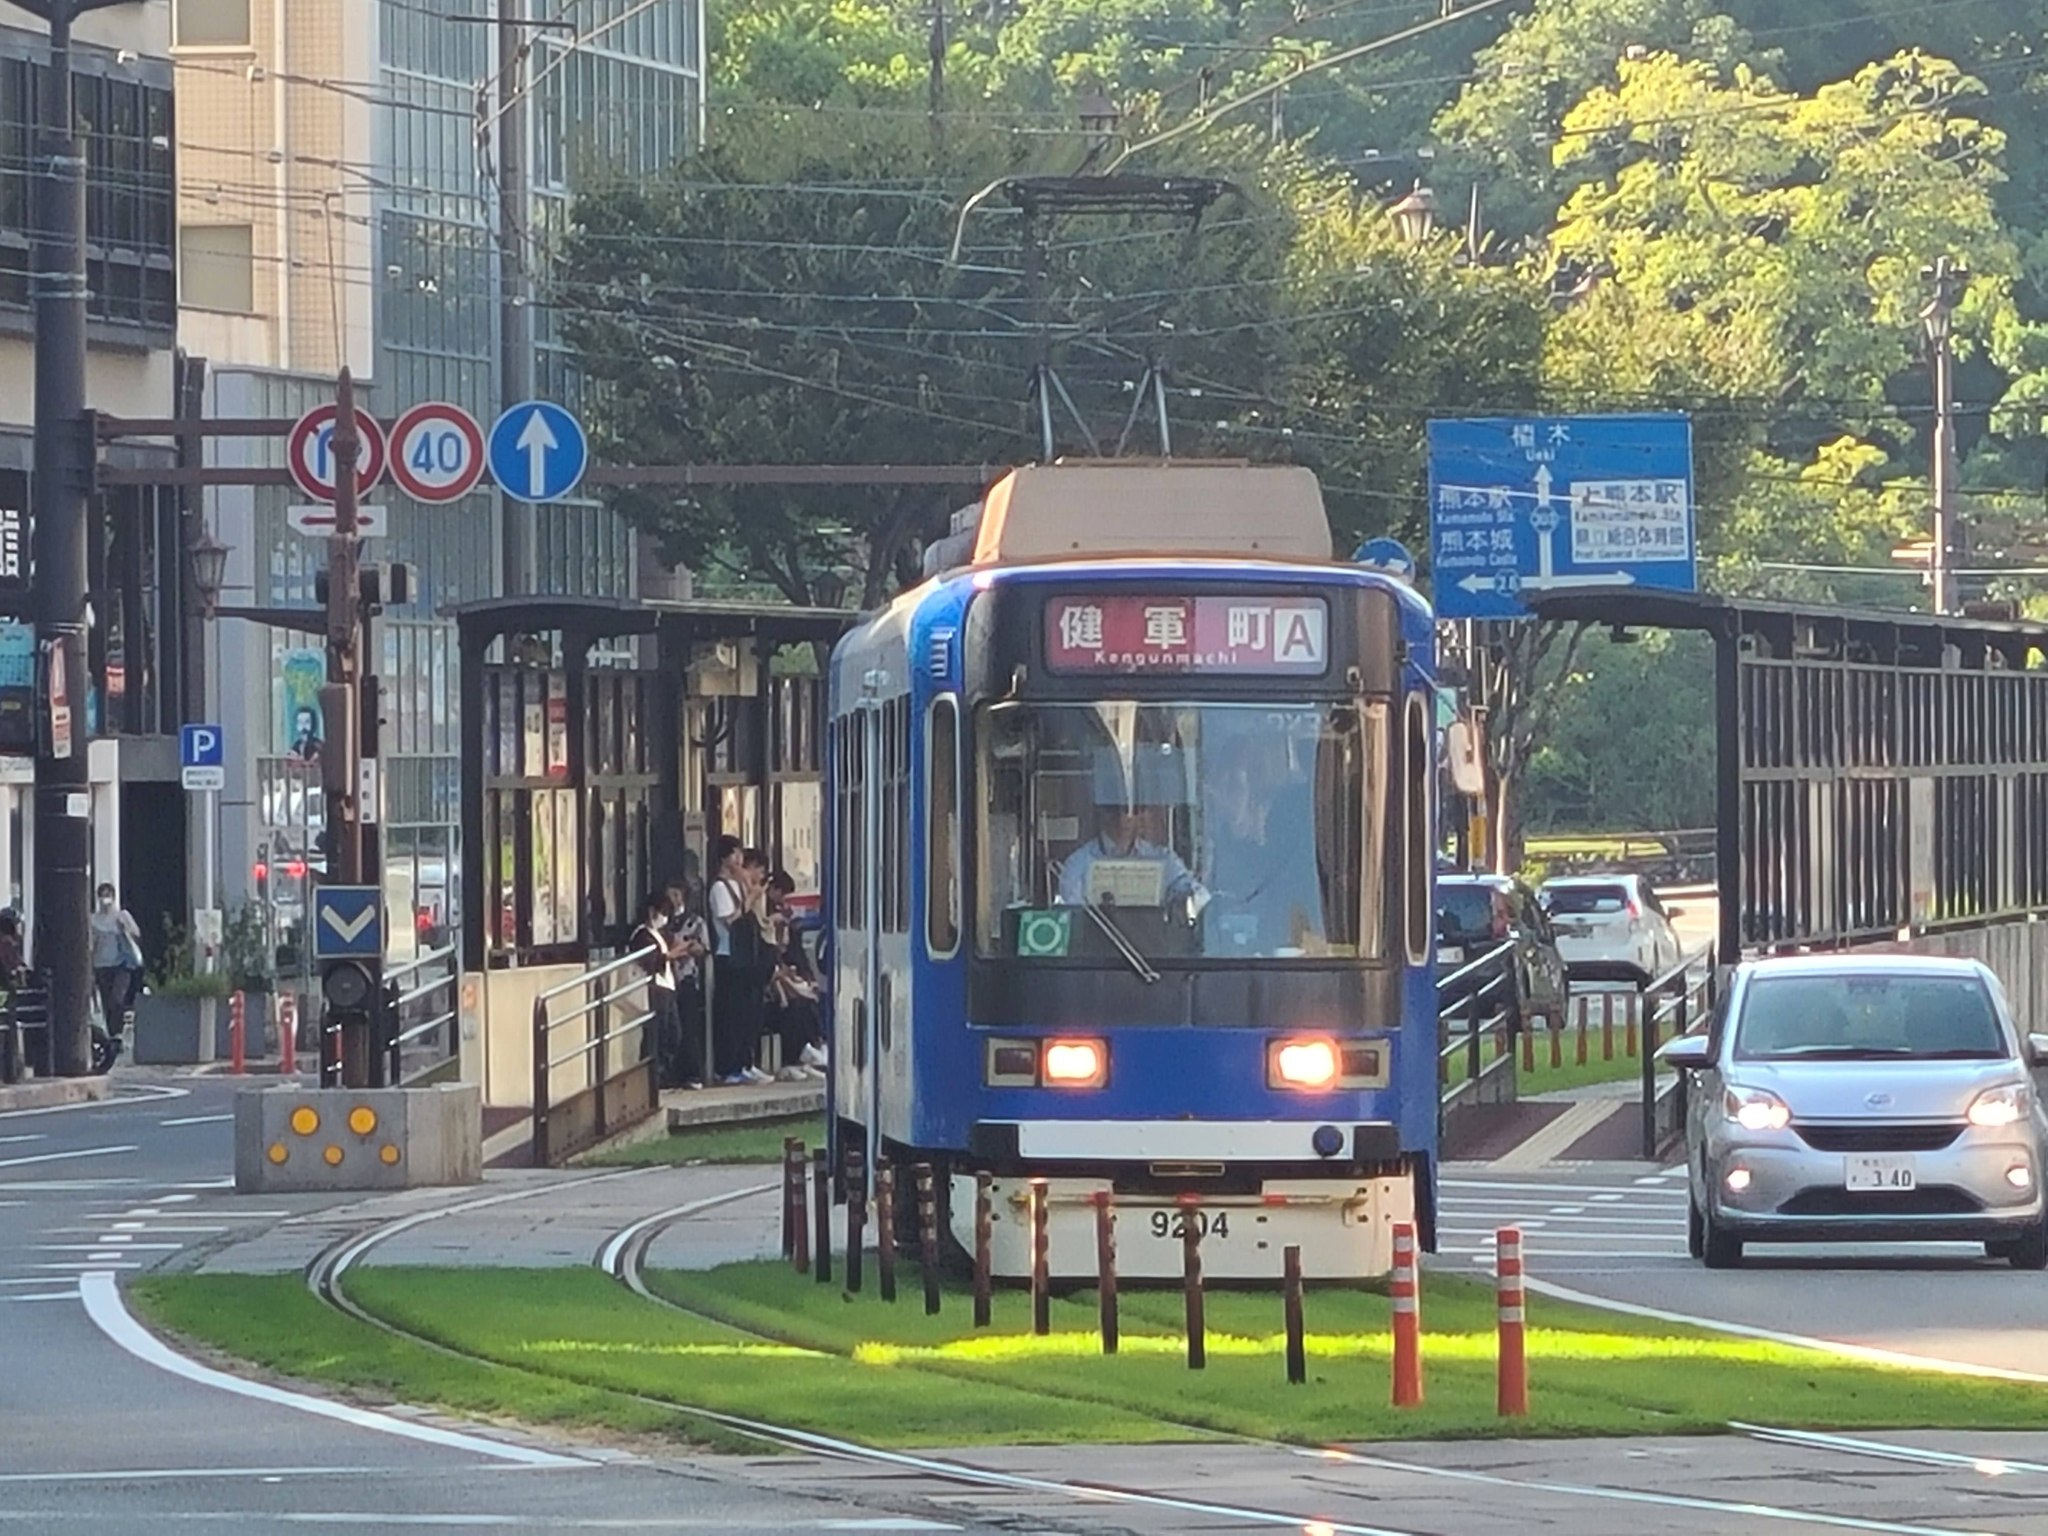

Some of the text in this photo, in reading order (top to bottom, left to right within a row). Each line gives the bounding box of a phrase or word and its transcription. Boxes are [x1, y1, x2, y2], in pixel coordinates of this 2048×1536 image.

[412, 431, 462, 474] 40
[1283, 614, 1315, 657] A
[1095, 651, 1237, 666] Kengunmachi
[193, 730, 215, 762] P
